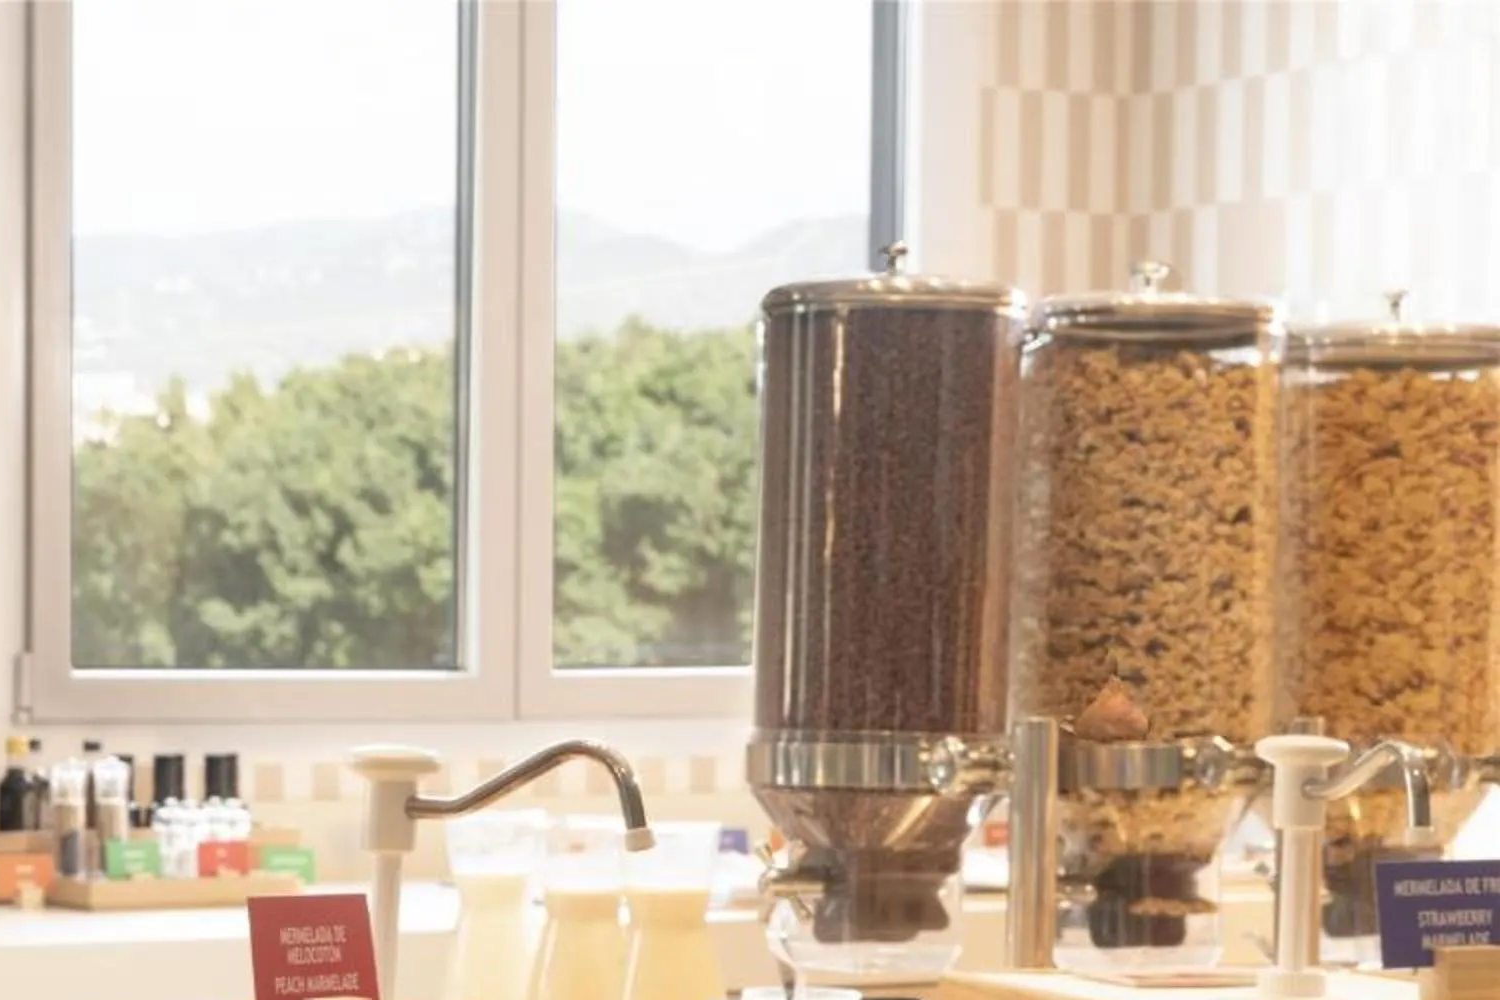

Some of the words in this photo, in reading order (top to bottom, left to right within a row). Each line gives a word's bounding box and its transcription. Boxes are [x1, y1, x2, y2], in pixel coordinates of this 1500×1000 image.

[1465, 877, 1480, 895] DE
[1417, 909, 1493, 929] STRAWBERRY
[275, 975, 305, 995] PEACH
